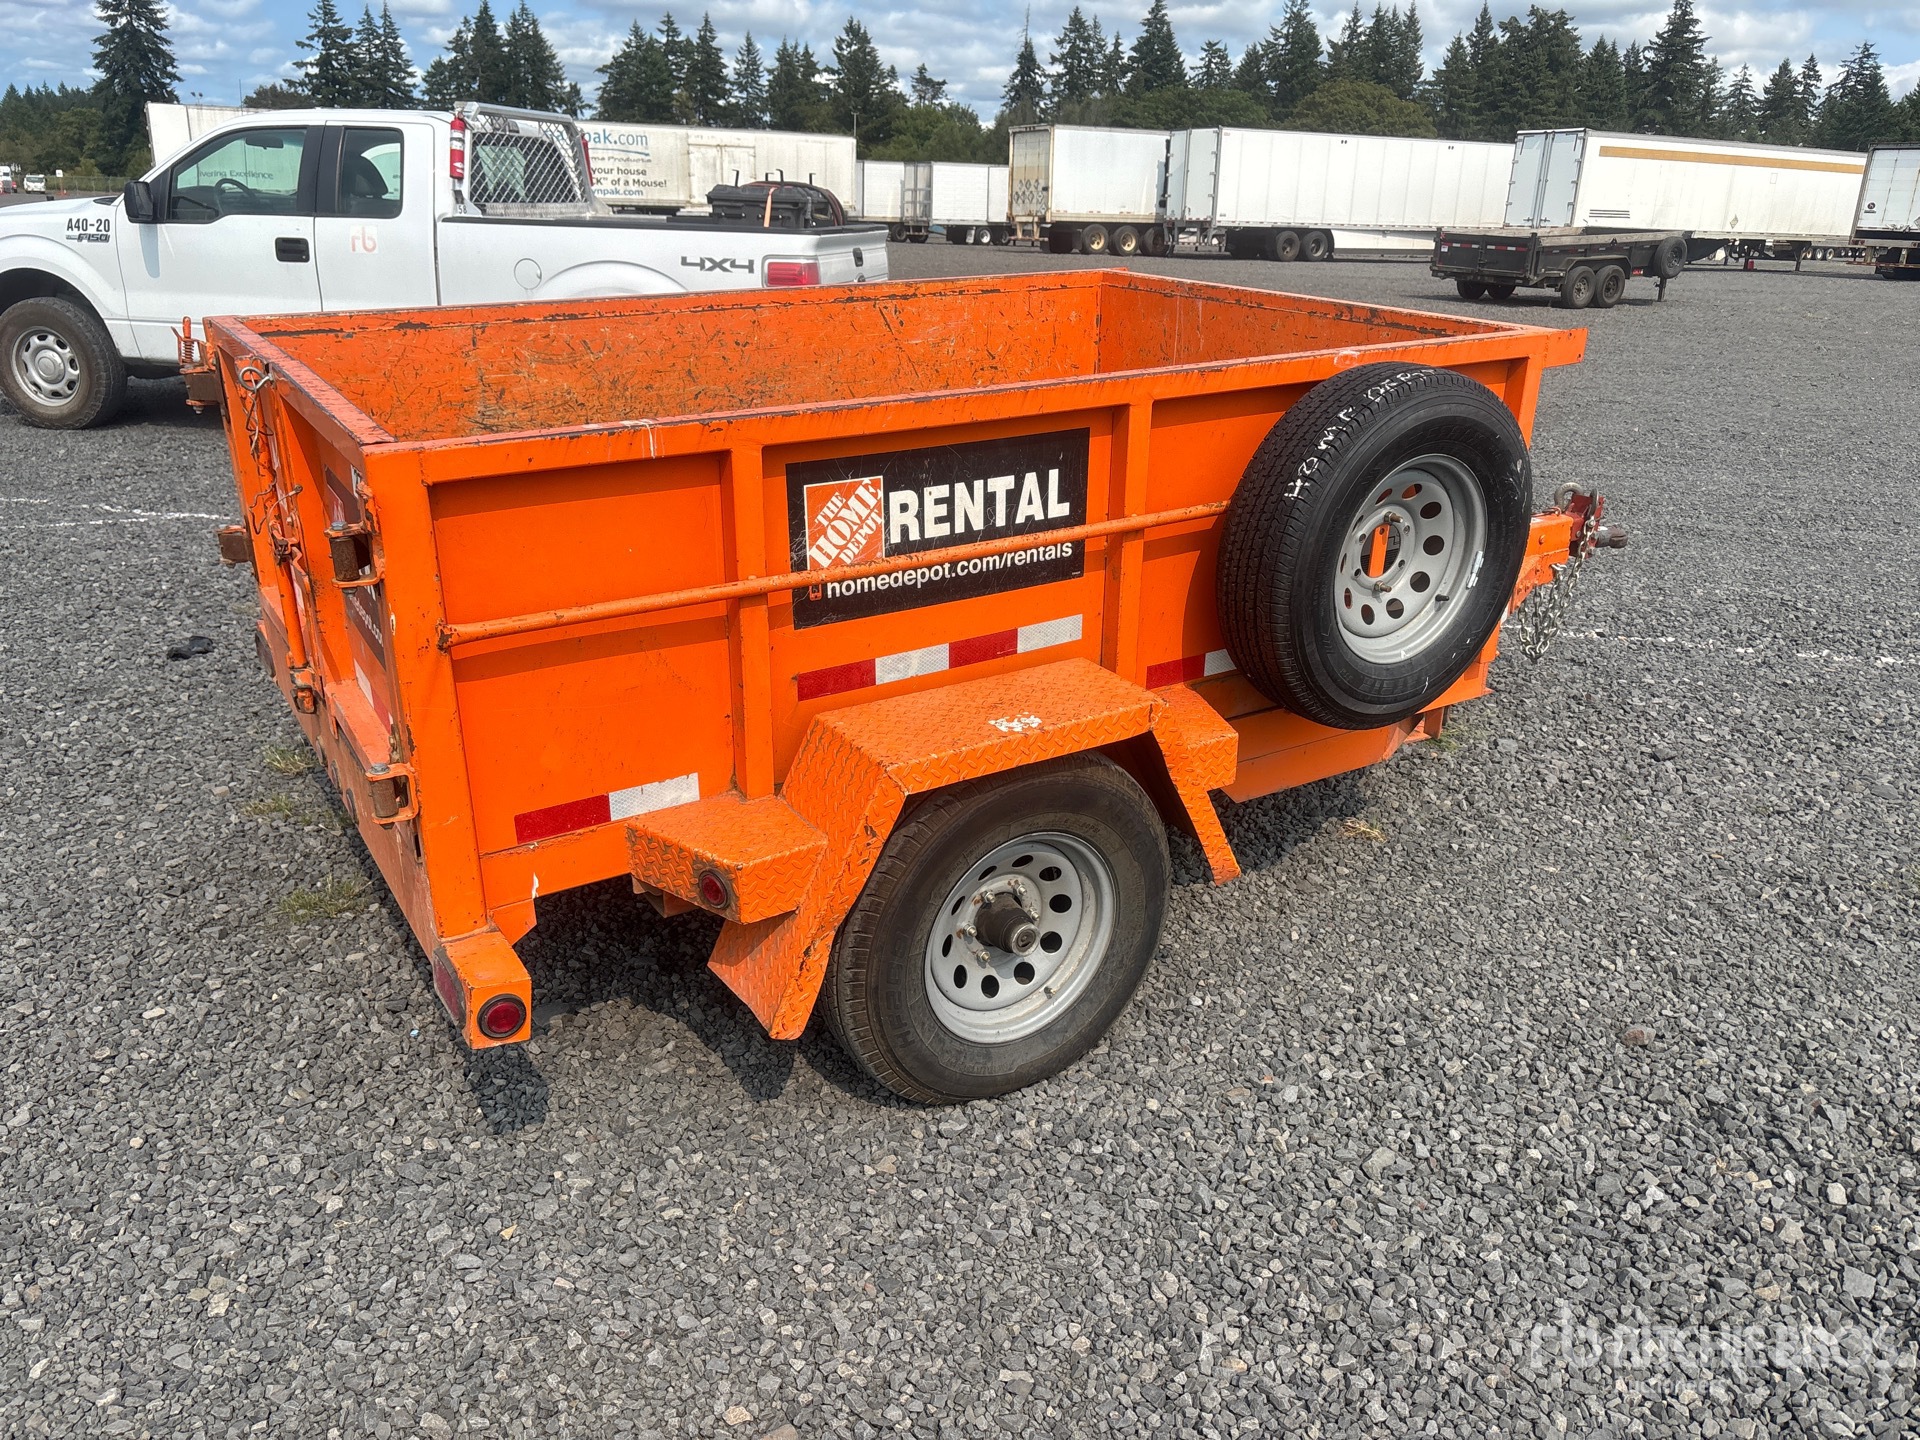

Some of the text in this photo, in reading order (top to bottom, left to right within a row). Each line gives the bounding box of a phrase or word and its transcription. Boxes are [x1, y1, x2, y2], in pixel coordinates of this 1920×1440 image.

[230, 169, 275, 180] Excellence
[591, 167, 648, 176] your house
[611, 178, 621, 186] of
[632, 178, 667, 188] Mouse!
[458, 204, 468, 215] 58
[66, 217, 111, 233] A40-20
[351, 226, 377, 253] rb
[814, 491, 847, 528] THE
[888, 468, 1071, 545] RENTAL
[808, 478, 883, 569] HOME
[838, 508, 883, 565] DEPOT
